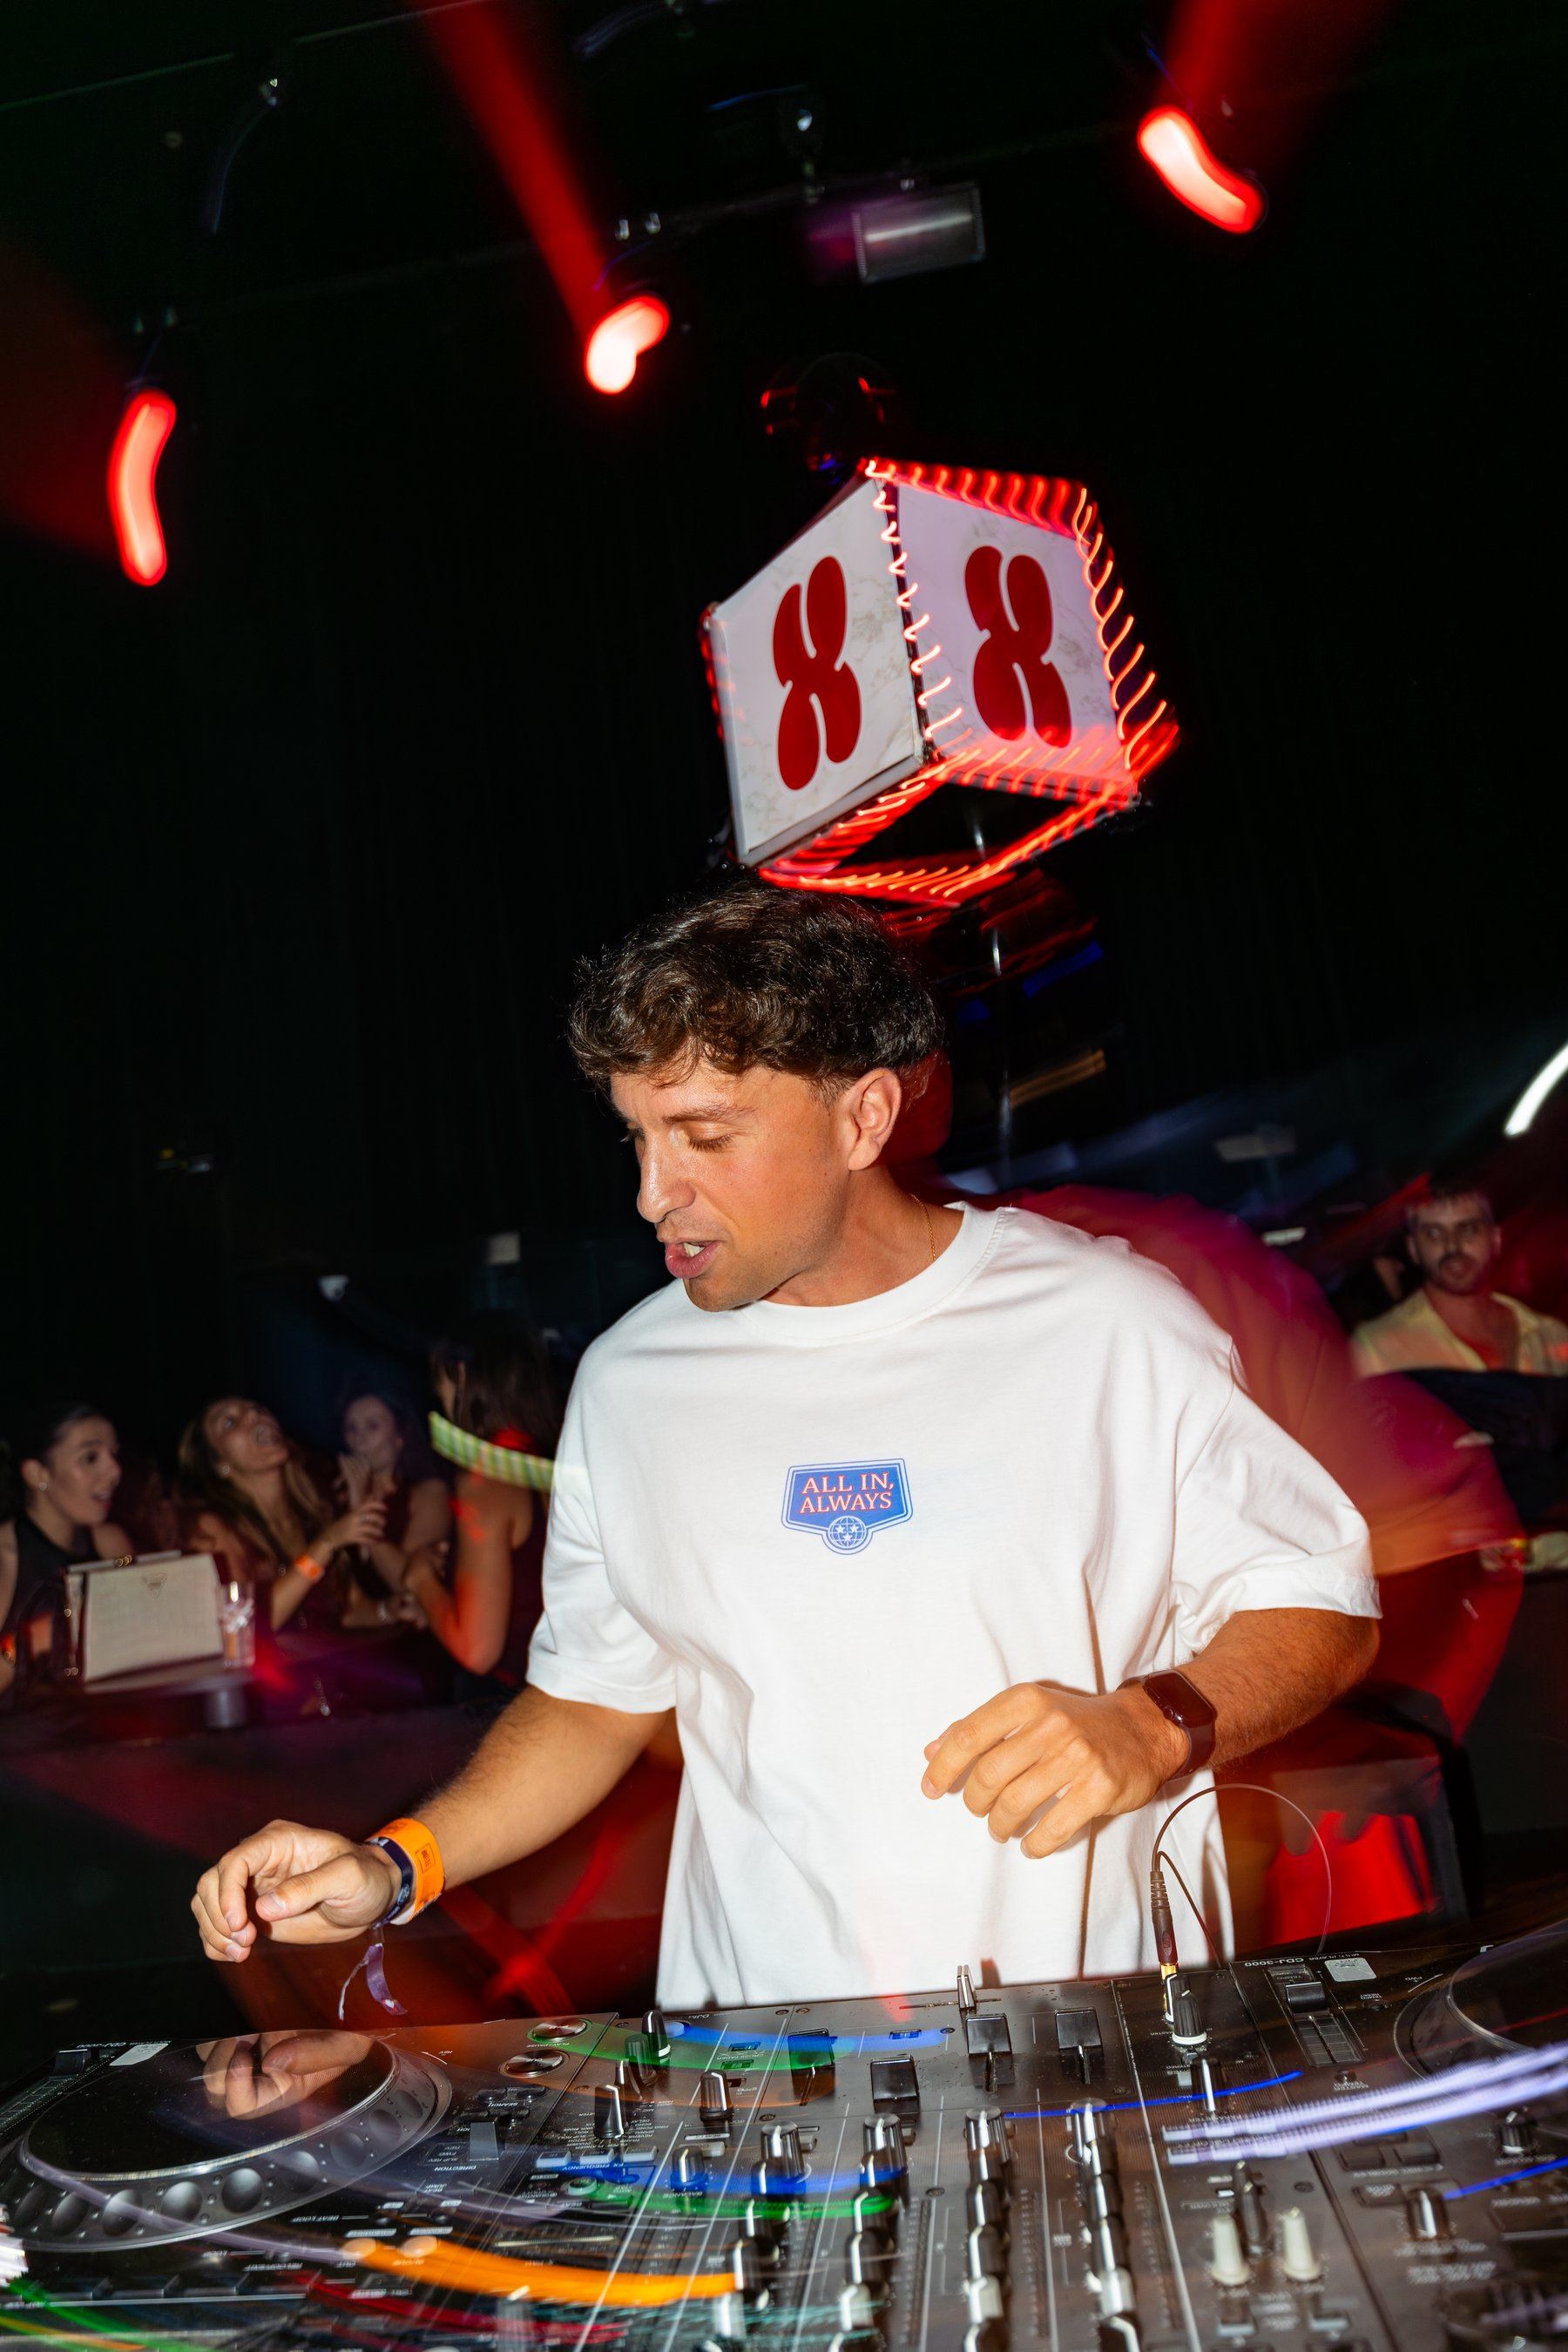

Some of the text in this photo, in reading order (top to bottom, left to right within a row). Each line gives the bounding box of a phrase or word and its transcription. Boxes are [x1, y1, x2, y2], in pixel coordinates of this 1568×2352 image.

[801, 1472, 895, 1495] ALL IN,
[799, 1491, 894, 1515] ALWAYS
[1244, 1957, 1305, 1968] CDJ-3000
[562, 2163, 611, 2172] FREQUENCY
